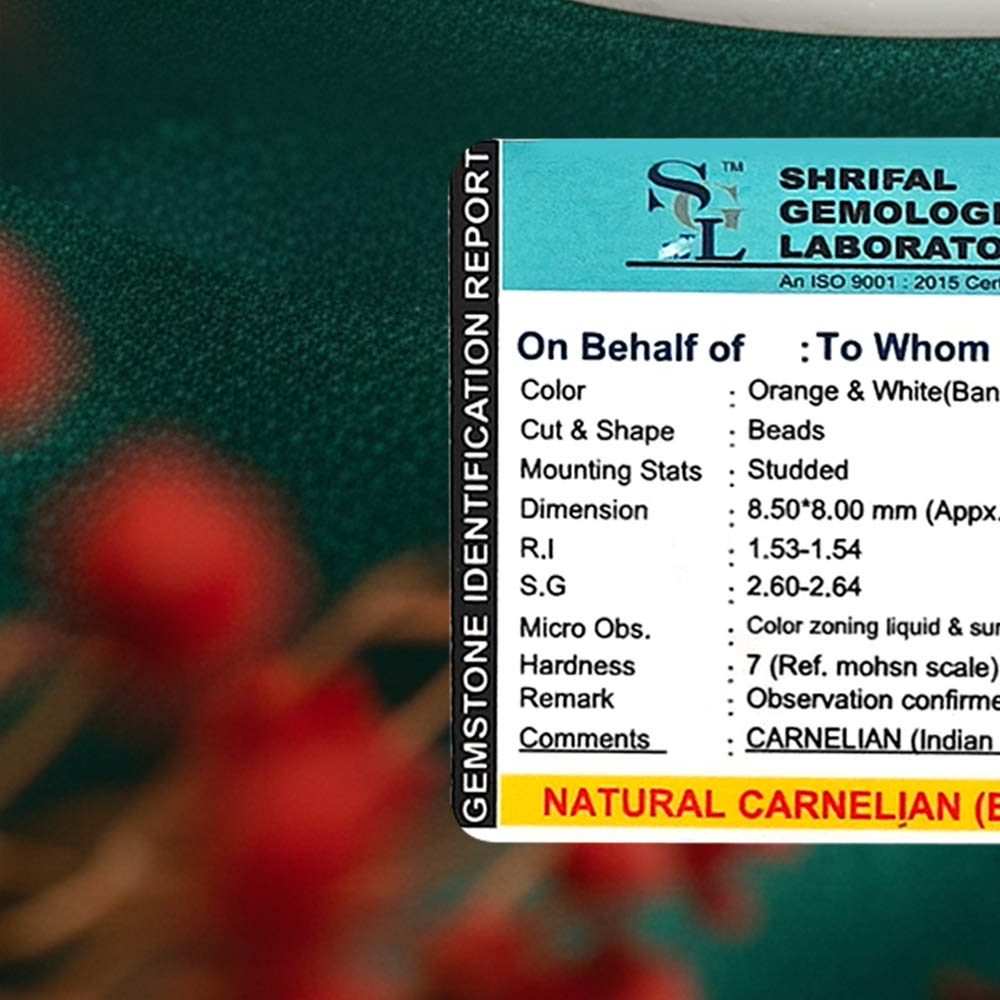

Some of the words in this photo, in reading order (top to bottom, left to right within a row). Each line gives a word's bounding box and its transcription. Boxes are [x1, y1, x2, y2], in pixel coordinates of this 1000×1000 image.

[778, 166, 958, 192] SHRIFAL
[464, 148, 490, 299] REPORT
[778, 273, 805, 289] An
[810, 273, 846, 290] ISO
[850, 274, 895, 292] 9001
[913, 274, 960, 291] 2015
[517, 331, 568, 361] On
[581, 331, 699, 362] Behalf
[708, 333, 746, 363] of
[873, 332, 990, 362] Whom
[520, 378, 587, 401] Color
[748, 378, 840, 407] Orange
[846, 379, 865, 402] &
[520, 418, 563, 441] Cut
[570, 418, 588, 441] &
[596, 418, 675, 446] Shape
[748, 418, 826, 441] Beads
[463, 313, 490, 601] IDENTIFICATION
[520, 457, 632, 487] Mounting
[640, 458, 703, 482] Stats
[747, 458, 849, 481] Studded
[520, 497, 649, 521] Dimension
[872, 504, 917, 521] mm
[520, 536, 554, 560] R.I
[749, 537, 862, 560] 1.53-1.54
[520, 574, 566, 597] S.G
[746, 574, 862, 598] 2.60-2.64
[520, 616, 586, 639] Micro
[594, 616, 651, 640] Obs.
[746, 614, 804, 635] Color
[809, 616, 879, 641] zoning
[886, 616, 941, 641] liquid
[947, 616, 963, 637] &
[520, 653, 636, 676] Hardness
[746, 653, 762, 676] 7
[769, 653, 827, 681] (Ref.
[836, 655, 918, 677] mohsn
[925, 656, 999, 683] scale)
[520, 686, 615, 709] Remark
[746, 686, 893, 710] Observation
[462, 615, 488, 823] GEMSTONE
[519, 728, 650, 749] Comments
[746, 728, 902, 749] CARNELIAN
[911, 728, 993, 752] (Indian
[543, 786, 726, 819] NATURAL
[738, 789, 961, 825] CARNELIAN
